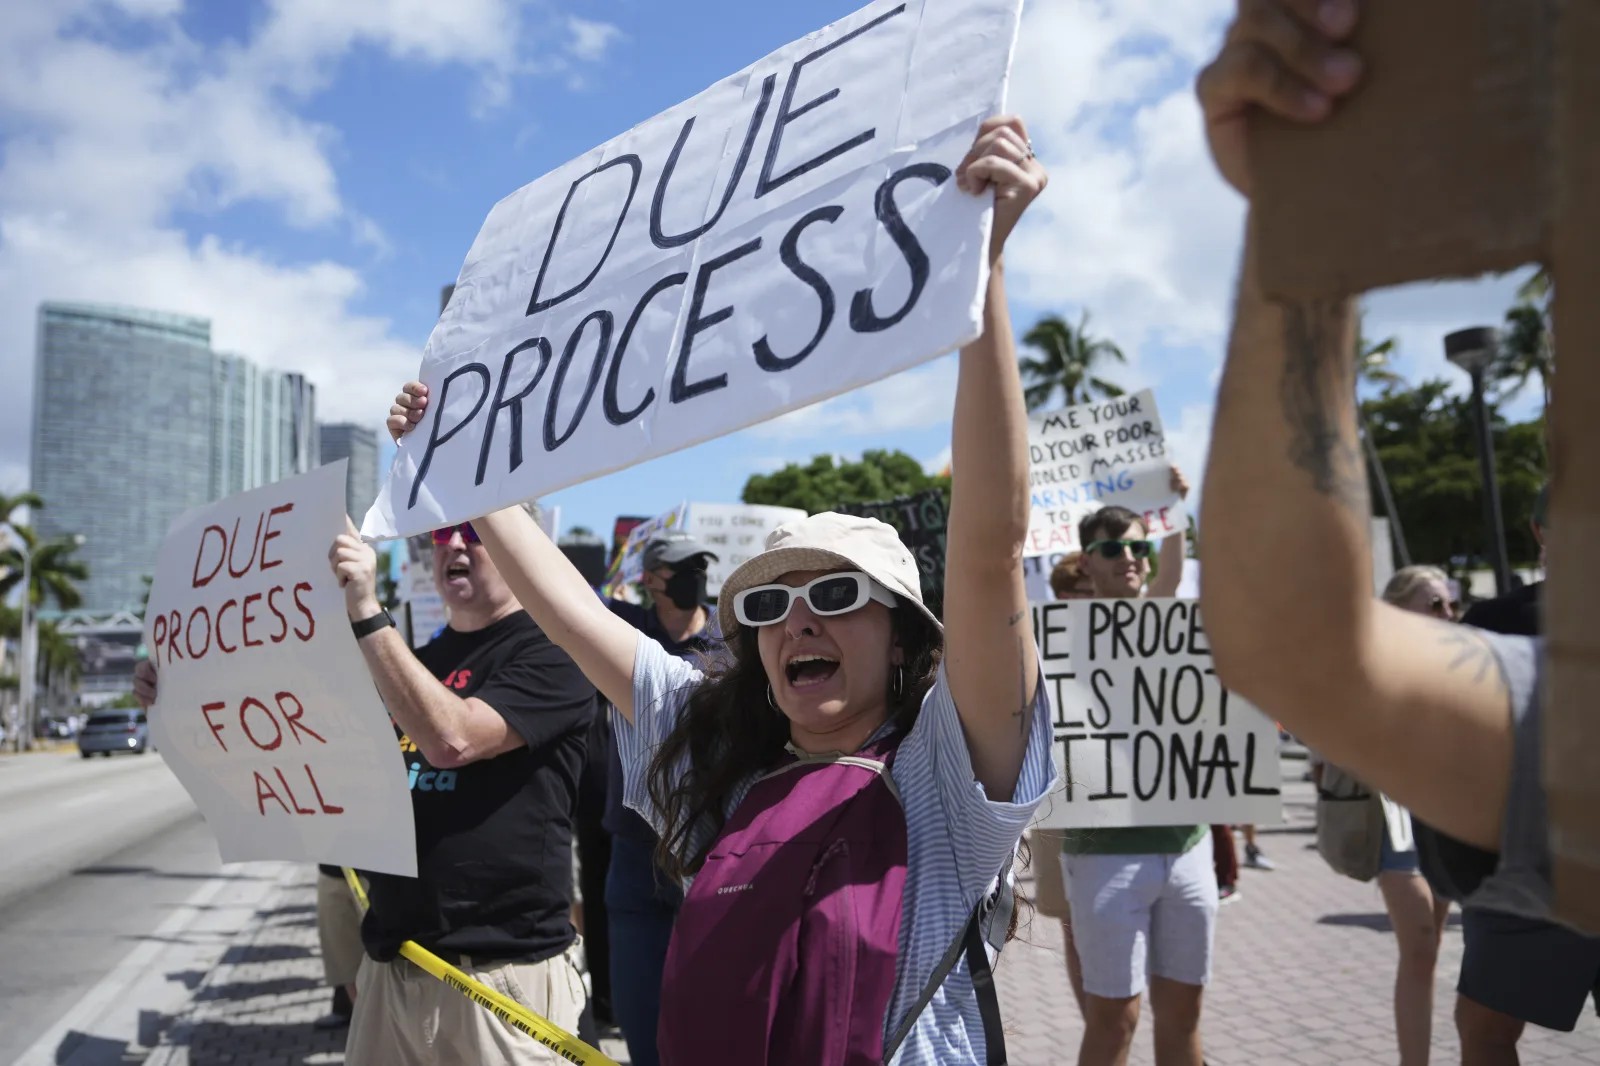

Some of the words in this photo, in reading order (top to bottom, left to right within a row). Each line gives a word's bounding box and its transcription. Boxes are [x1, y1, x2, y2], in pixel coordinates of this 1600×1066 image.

[525, 3, 906, 317] DUE
[407, 161, 952, 510] PROCESS
[1041, 411, 1080, 435] ME
[1088, 396, 1142, 424] YOUR
[1045, 433, 1099, 461] YOUR
[1104, 420, 1160, 448] POOR
[1090, 438, 1166, 475] MASSES
[192, 502, 295, 588] DUE
[1025, 524, 1072, 551] EAT
[1045, 510, 1070, 524] TO
[153, 581, 316, 667] PROCESS
[202, 691, 327, 752] FOR
[1045, 668, 1114, 729] IS
[1132, 665, 1228, 726] NOT
[253, 764, 344, 816] ALL
